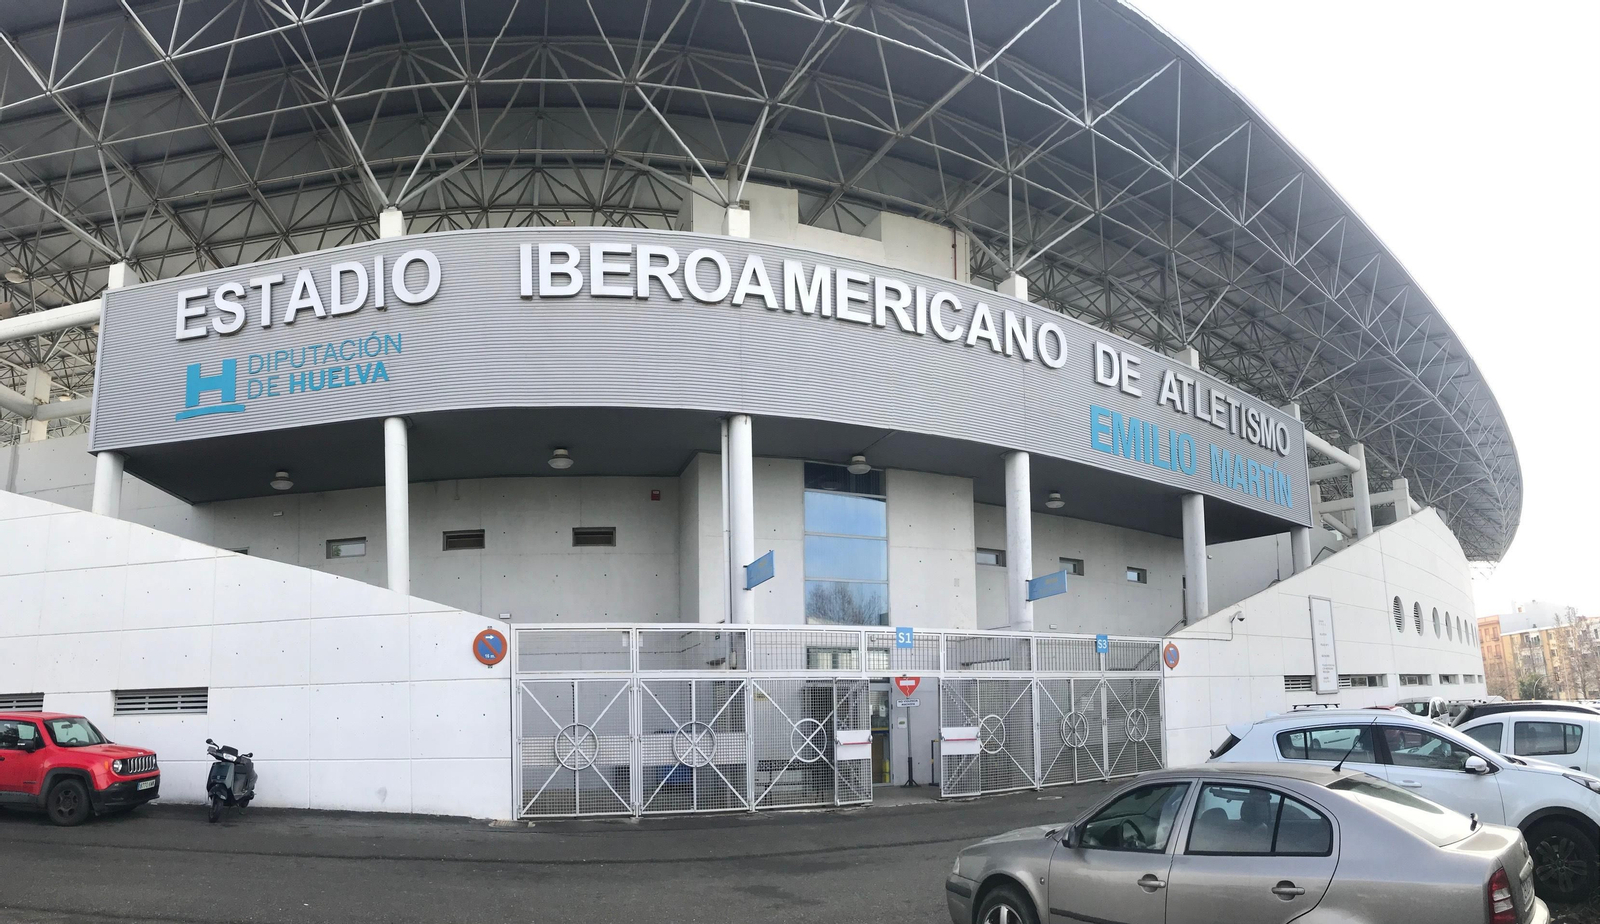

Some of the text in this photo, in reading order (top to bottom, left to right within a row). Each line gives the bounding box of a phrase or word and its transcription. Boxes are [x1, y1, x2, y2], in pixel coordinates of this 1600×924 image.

[174, 242, 1291, 457] ESTADIO IBEROAMERICANO DE ATLETISMO
[248, 331, 402, 375] DIPUTACIÓN
[247, 361, 390, 400] DE HUELVA
[1090, 404, 1293, 509] EMILIO MARTÍN
[898, 632, 912, 644] S1
[1097, 639, 1108, 650] S3
